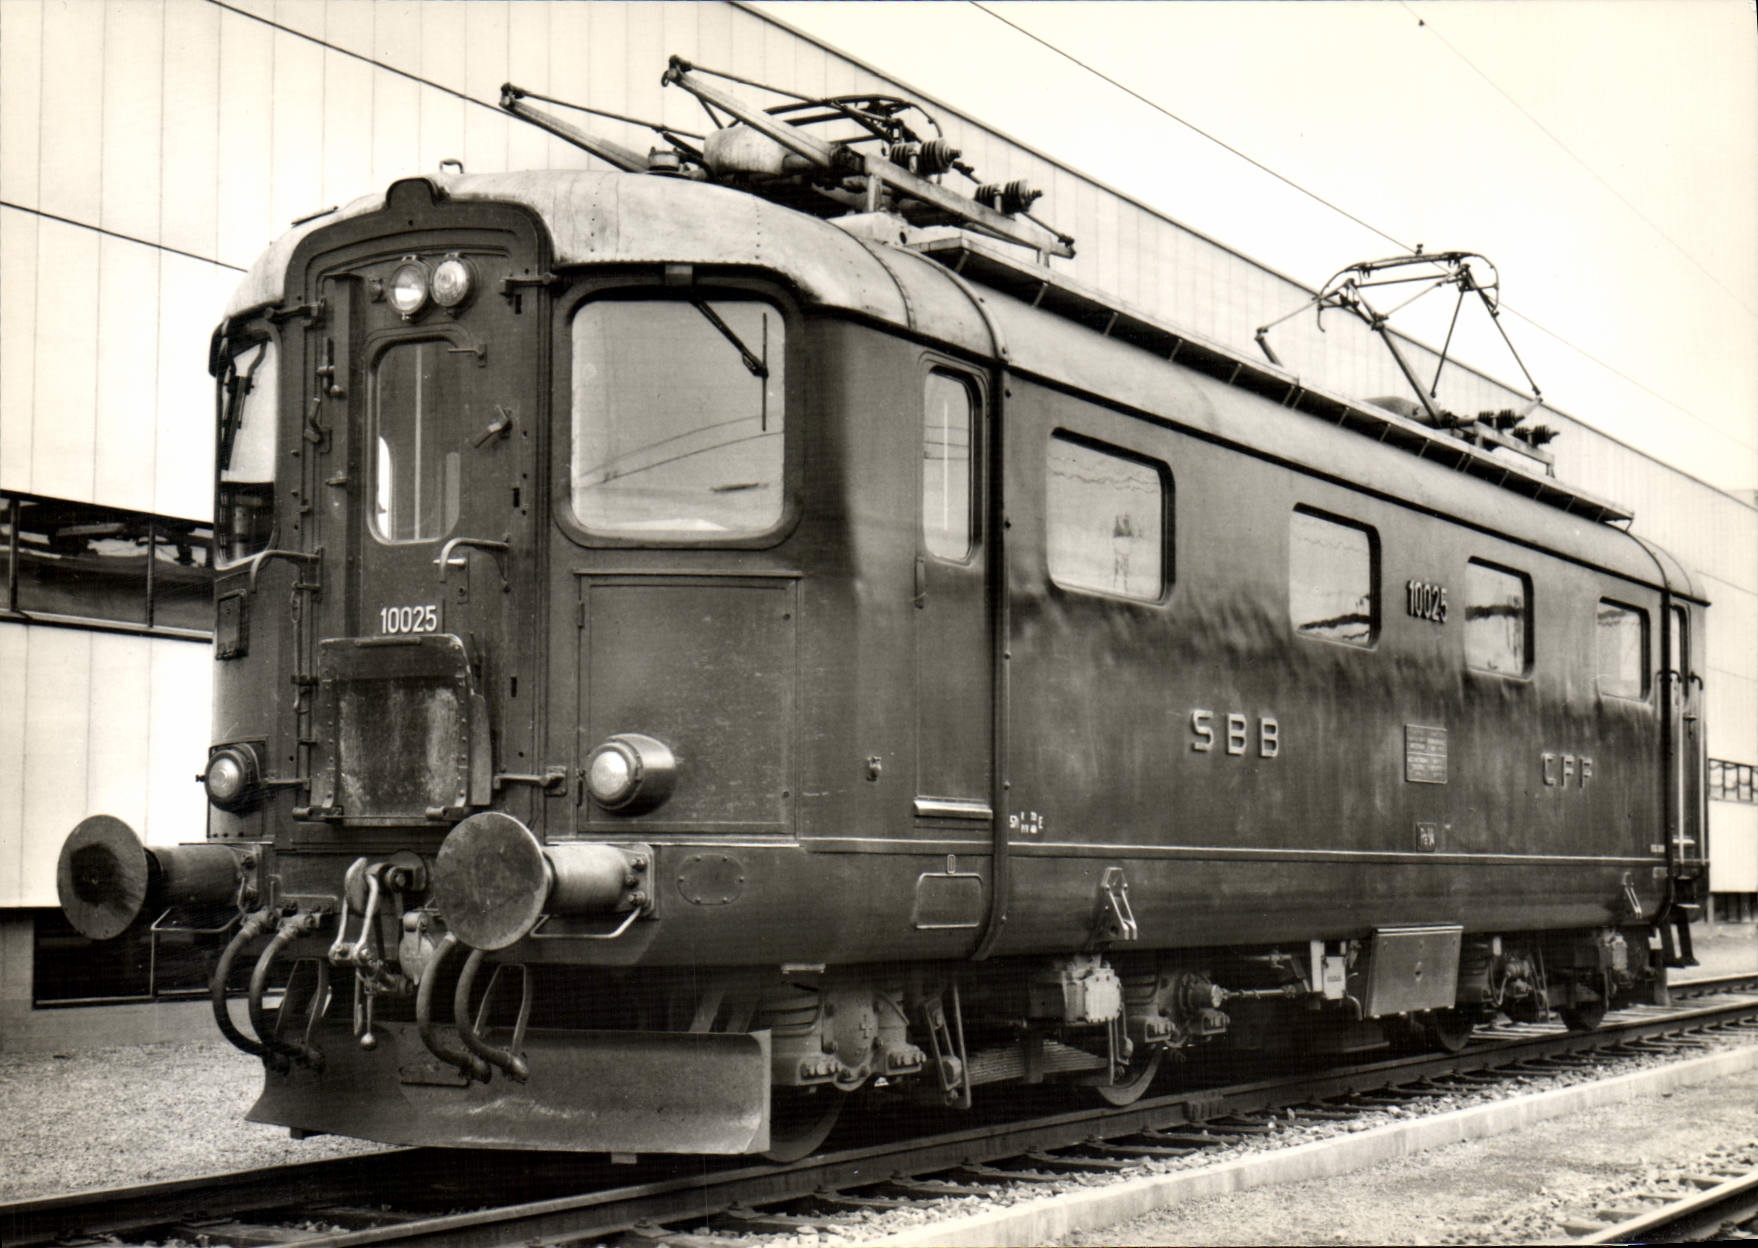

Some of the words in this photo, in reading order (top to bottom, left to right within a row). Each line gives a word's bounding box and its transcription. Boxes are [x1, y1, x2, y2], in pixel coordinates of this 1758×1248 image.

[380, 605, 437, 634] 10025
[1406, 580, 1448, 623] 10025
[1191, 709, 1279, 758] SBB
[1541, 752, 1593, 789] CFF
